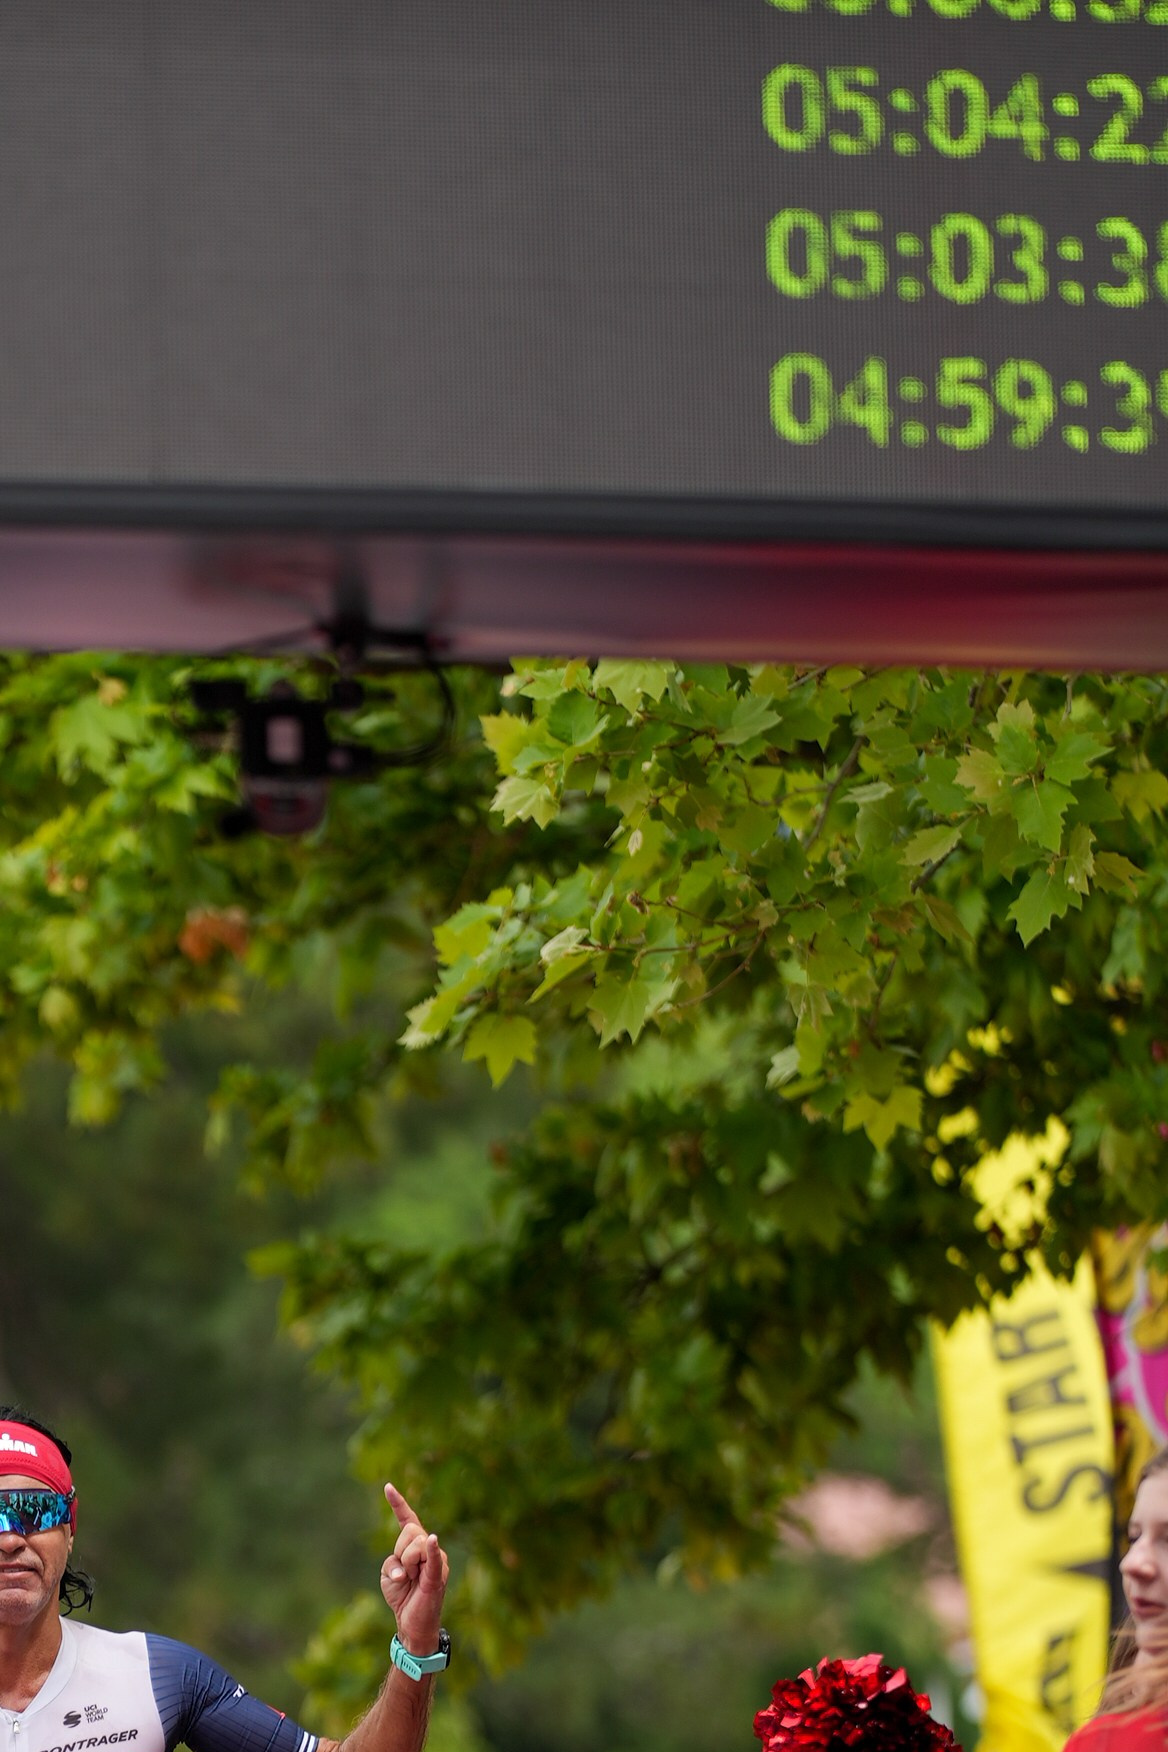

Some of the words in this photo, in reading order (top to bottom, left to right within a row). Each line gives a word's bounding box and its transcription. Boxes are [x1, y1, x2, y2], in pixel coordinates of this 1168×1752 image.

[992, 1302, 1116, 1518] STAR
[84, 1704, 97, 1712] UCI
[87, 1714, 104, 1723] TEAM
